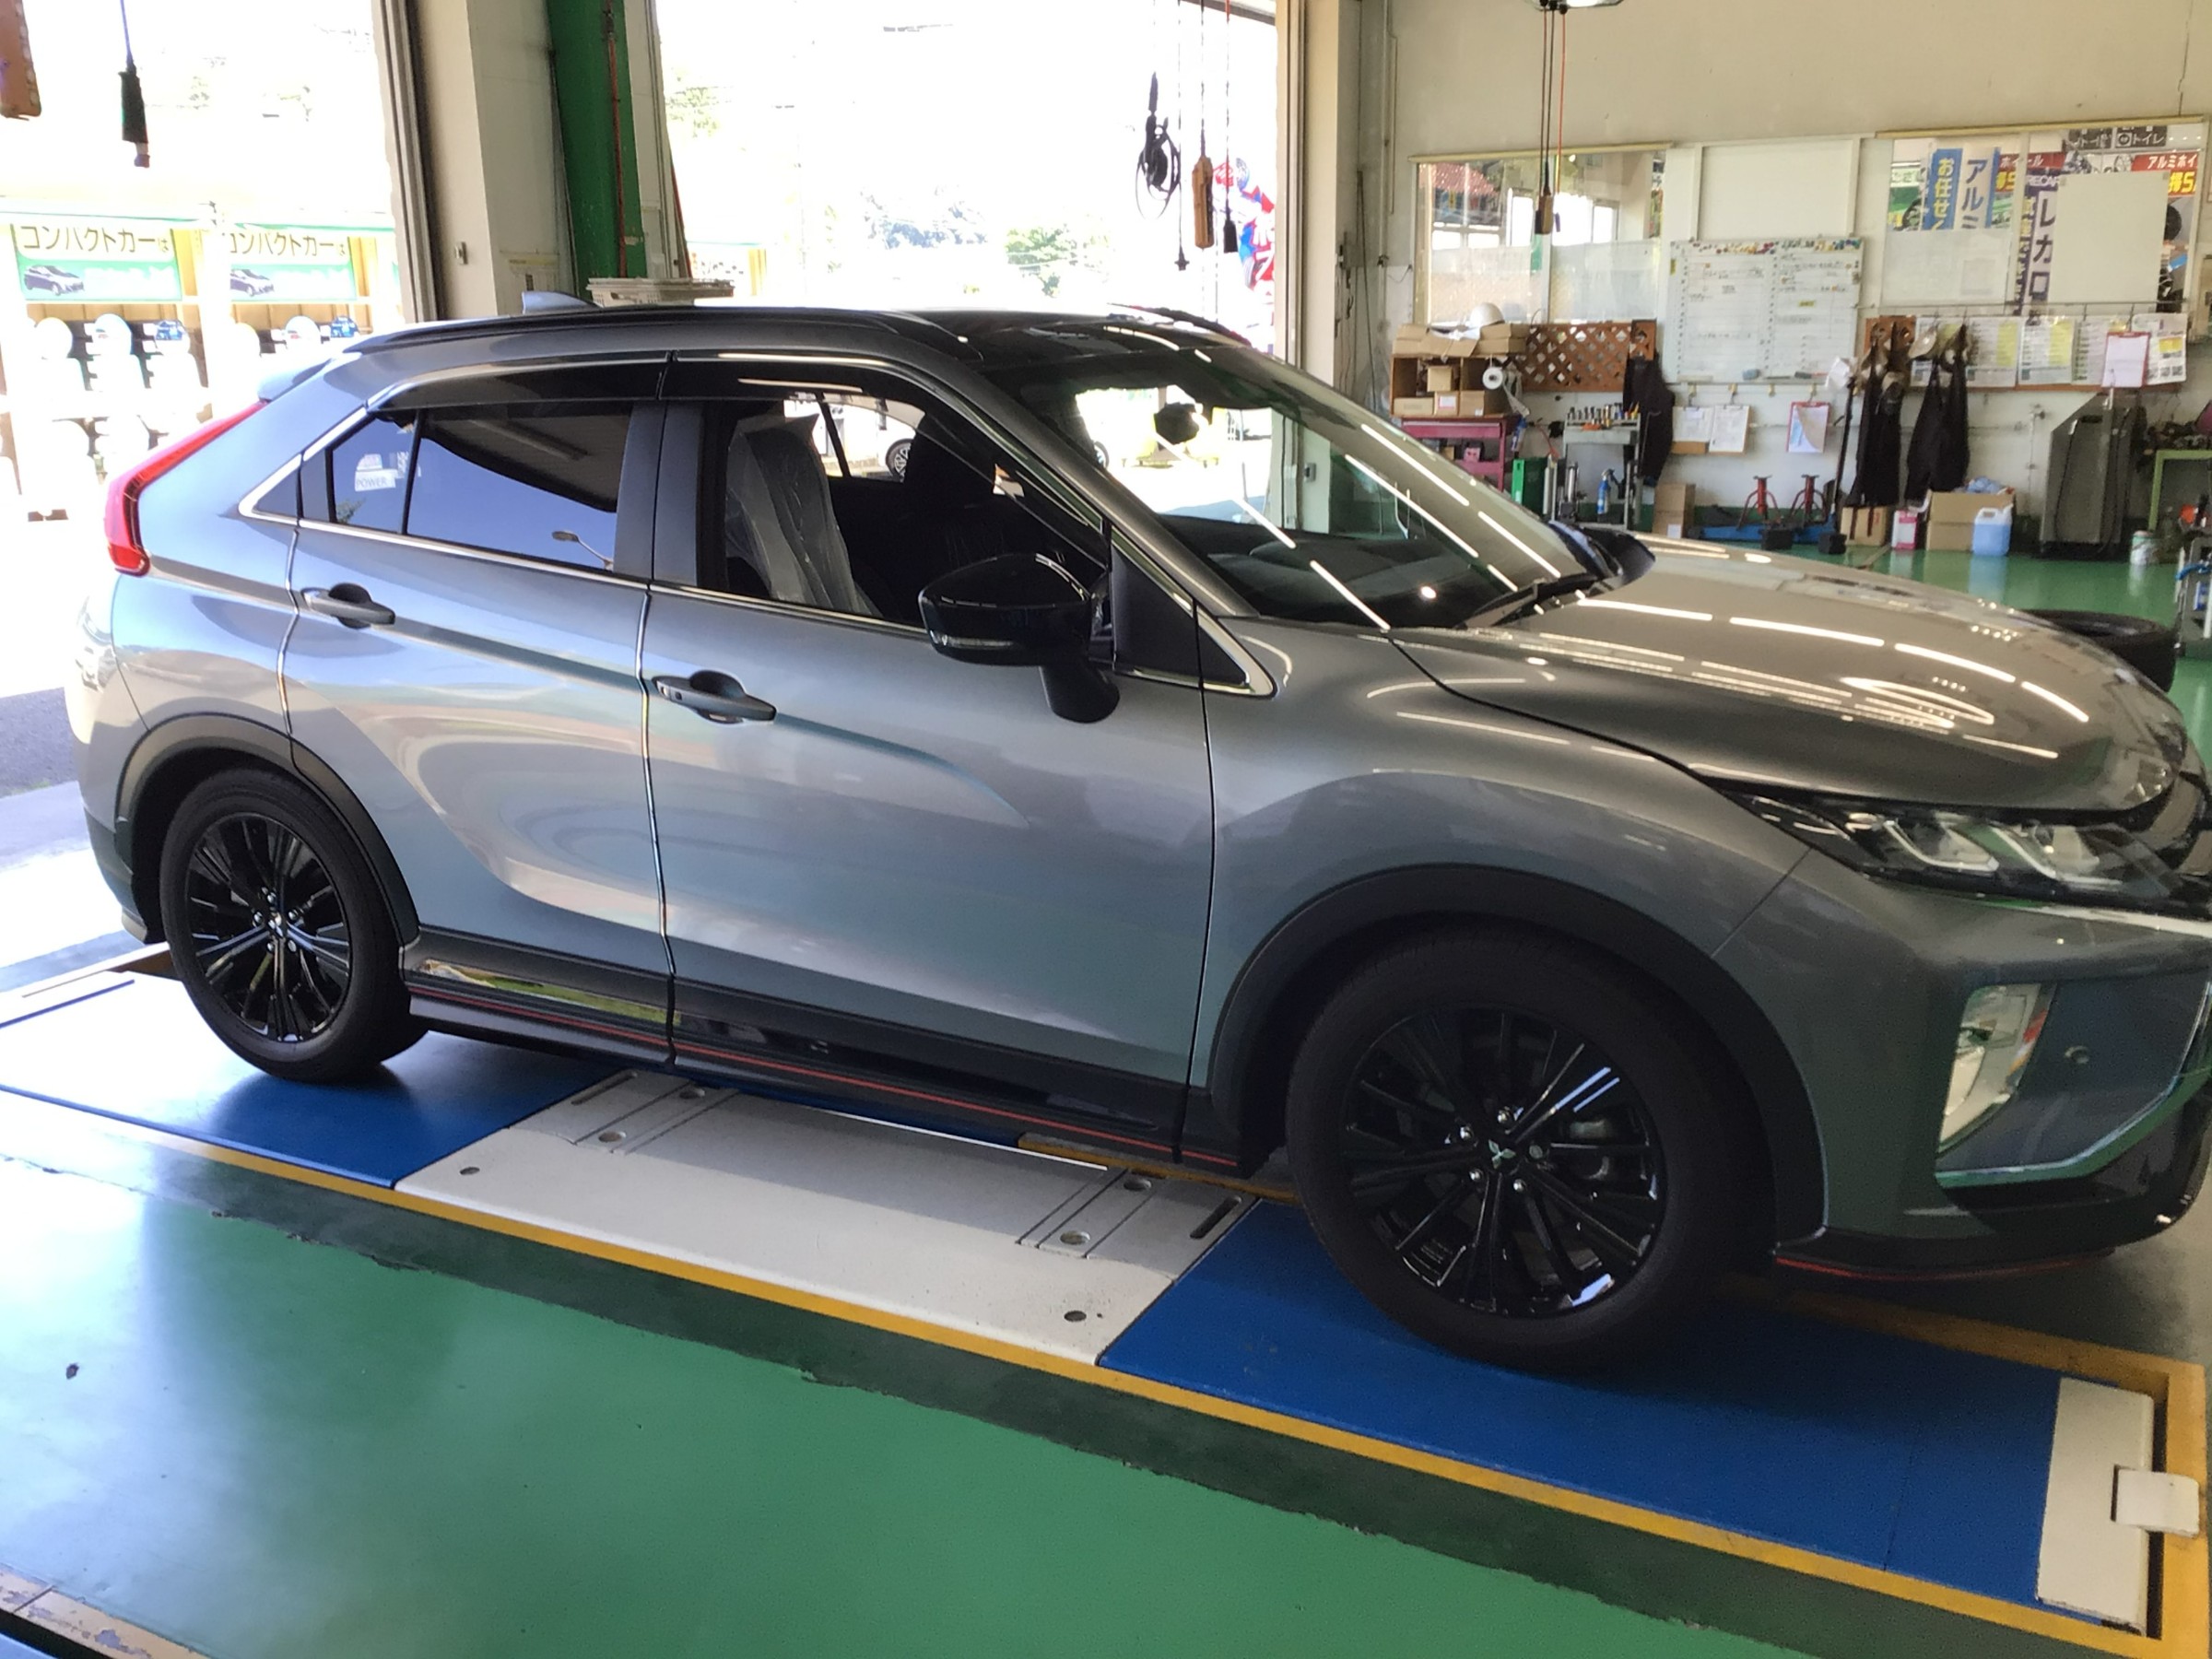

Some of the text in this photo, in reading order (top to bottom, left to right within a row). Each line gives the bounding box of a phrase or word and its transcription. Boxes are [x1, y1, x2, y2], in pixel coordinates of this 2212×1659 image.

[2133, 133, 2165, 146] トイレ
[356, 476, 387, 488] POWER
